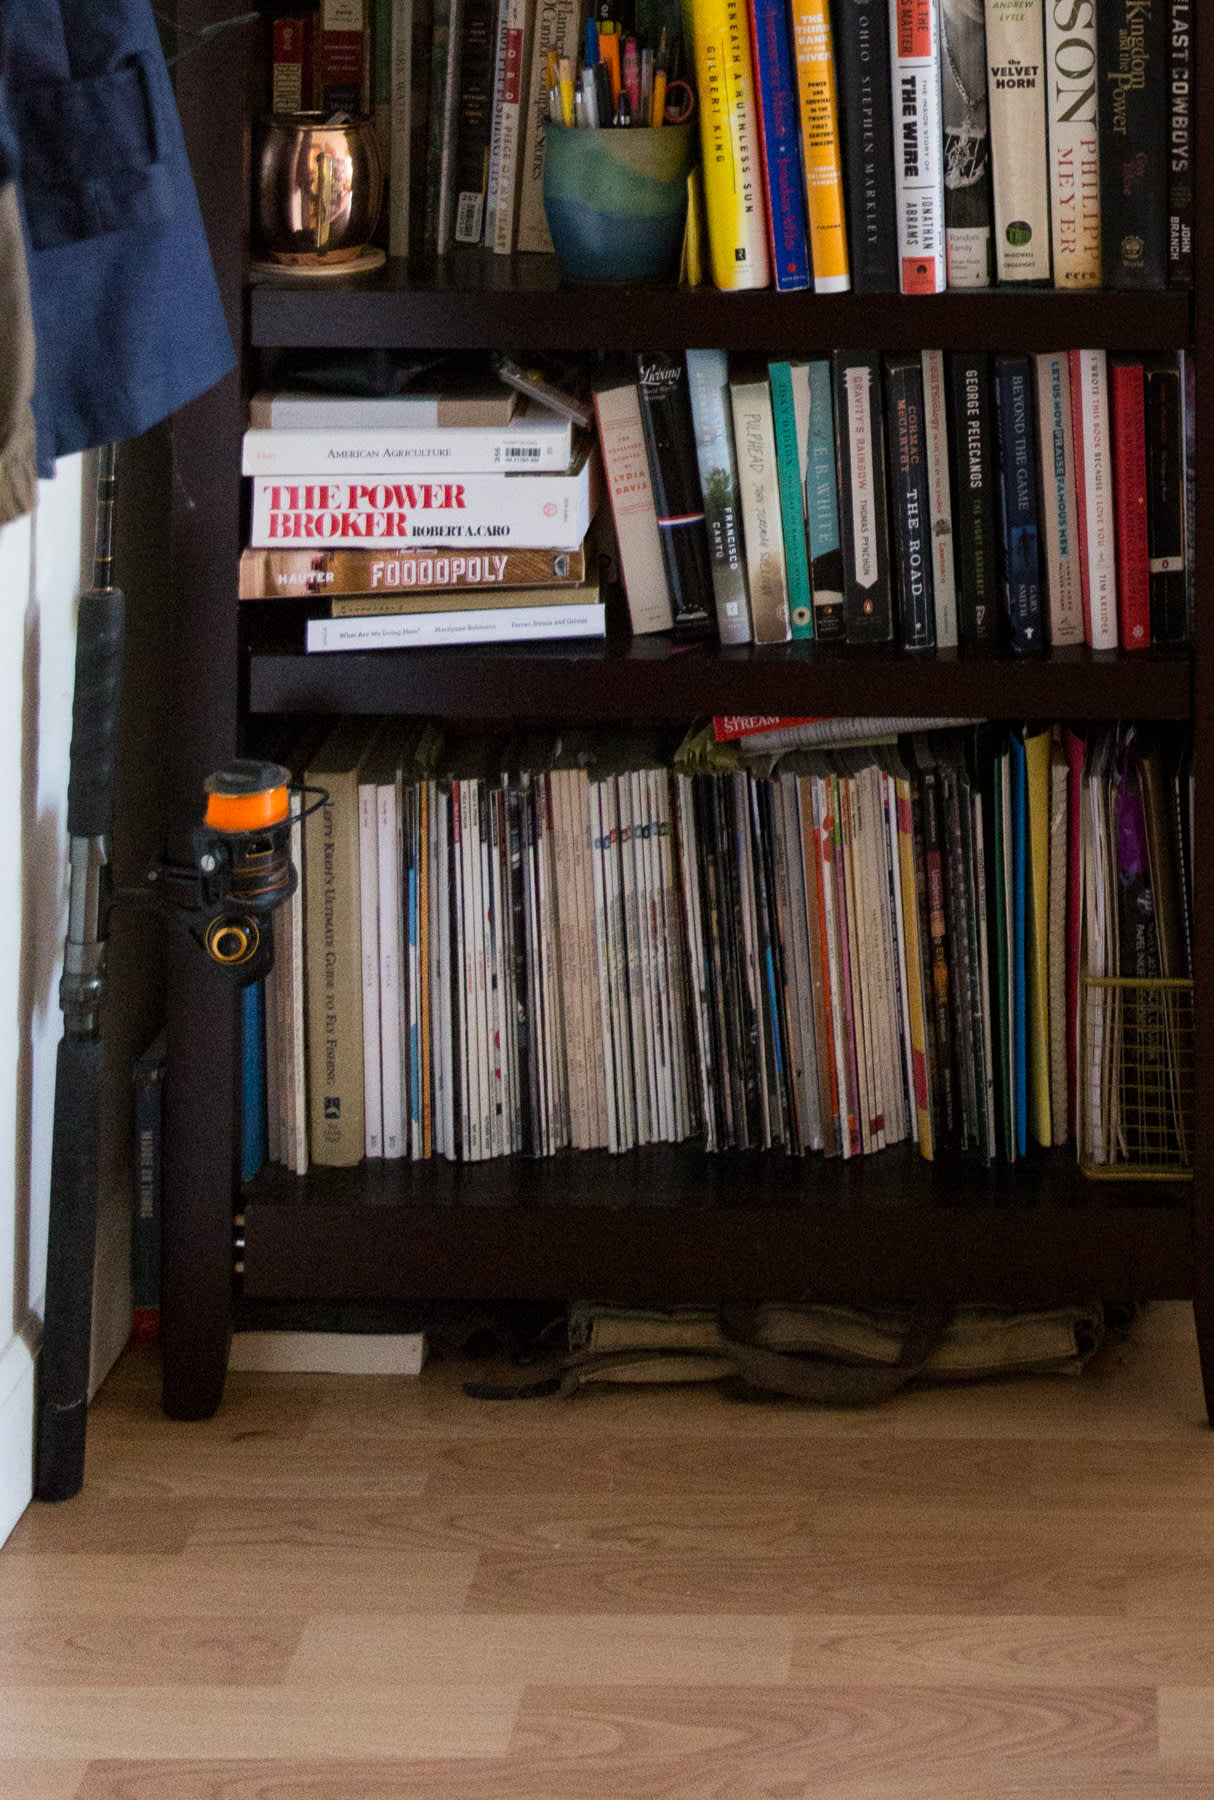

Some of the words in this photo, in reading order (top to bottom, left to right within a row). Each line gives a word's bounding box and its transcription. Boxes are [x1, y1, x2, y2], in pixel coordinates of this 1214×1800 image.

[600, 4, 611, 19] OF
[800, 14, 825, 25] THE
[918, 10, 930, 32] THE
[992, 1, 1034, 9] ANDREW
[557, 0, 574, 61] Flanner
[795, 24, 829, 35] THIRD
[798, 34, 828, 45] BANK
[859, 16, 873, 62] OHIO
[902, 9, 914, 53] MATTER
[1118, 28, 1130, 50] and
[1124, 0, 1152, 89] Kingdom
[1171, 5, 1188, 59] LAST
[504, 30, 518, 101] FORD
[797, 51, 832, 63] RIVER
[991, 65, 1039, 77] VELVET
[1118, 53, 1131, 71] the
[901, 76, 917, 118] THE
[996, 78, 1036, 89] HORN
[1107, 71, 1134, 134] Power
[705, 46, 721, 114] GILBERT
[713, 125, 725, 163] KING
[861, 76, 876, 152] STEPHEN
[1172, 68, 1190, 172] COWBOYS
[502, 127, 512, 158] PIECE
[735, 91, 750, 173] RUTHLESS
[743, 184, 754, 214] SUN
[903, 121, 919, 179] WIRE
[864, 163, 879, 245] MARKLEY
[1057, 148, 1077, 255] MEYER
[1081, 139, 1099, 260] PHILIPP
[497, 208, 508, 249] HEART
[782, 216, 798, 251] Miles
[906, 202, 919, 246] ABRAMS
[921, 196, 934, 250] JONATHAN
[1170, 216, 1180, 260] BRANCH
[1181, 224, 1191, 253] JOHN
[1051, 361, 1060, 382] LET
[1053, 384, 1061, 398] US
[1091, 365, 1100, 396] WROTE
[777, 382, 790, 414] JOAN
[853, 376, 867, 433] GRAVITY'S
[966, 370, 980, 416] GEORGE
[1011, 375, 1026, 432] BEYOND
[1092, 399, 1101, 419] THIS
[1053, 401, 1062, 428] NOW
[328, 448, 380, 459] AMERICAN
[383, 447, 453, 458] AGRICULTURE
[744, 413, 764, 472] PULPHEAD
[782, 419, 794, 465] DIDION
[897, 400, 909, 473] McCARTHY
[908, 405, 920, 464] CORMAC
[968, 420, 983, 488] PELECANOS
[1015, 436, 1027, 465] THE
[1054, 430, 1065, 476] PRAISE
[1093, 422, 1101, 448] BOOK
[813, 447, 829, 462] E.
[814, 464, 830, 479] B.
[856, 437, 868, 489] RAINBOW
[1094, 452, 1103, 491] BECAUSE
[614, 471, 645, 482] LYDIA
[616, 482, 648, 495] DAVIS
[1016, 468, 1029, 511] GAME
[263, 484, 342, 511] THE
[349, 484, 467, 510] POWER
[815, 482, 832, 543] WHITE
[860, 499, 870, 533] THOMAS
[906, 489, 920, 529] THE
[1056, 478, 1067, 524] FAMOUS
[1096, 501, 1104, 524] LOVE
[267, 512, 409, 538] BROKER
[412, 525, 464, 537] ROBERT
[711, 521, 724, 558] CANTÚ
[724, 506, 738, 570] FRANCISCO
[1059, 528, 1068, 555] MEN
[1097, 527, 1105, 546] YOU
[278, 571, 334, 585] HAUTER
[371, 555, 509, 588] FOODOPOLY
[861, 535, 872, 576] PYNCHON
[909, 540, 923, 596] ROAD
[1018, 584, 1028, 617] SMITH
[1099, 574, 1107, 591] TIM
[724, 715, 781, 734] STREAM
[323, 802, 336, 839] LEFTY
[324, 842, 337, 884] KREH'S
[324, 888, 338, 947] ULTIMATE
[930, 868, 943, 944] Understanding
[325, 951, 338, 990] GUIDE
[934, 946, 947, 1004] EXPOSURE
[326, 994, 337, 1010] TO
[326, 1013, 338, 1035] FLY
[326, 1038, 339, 1085] FISHING
